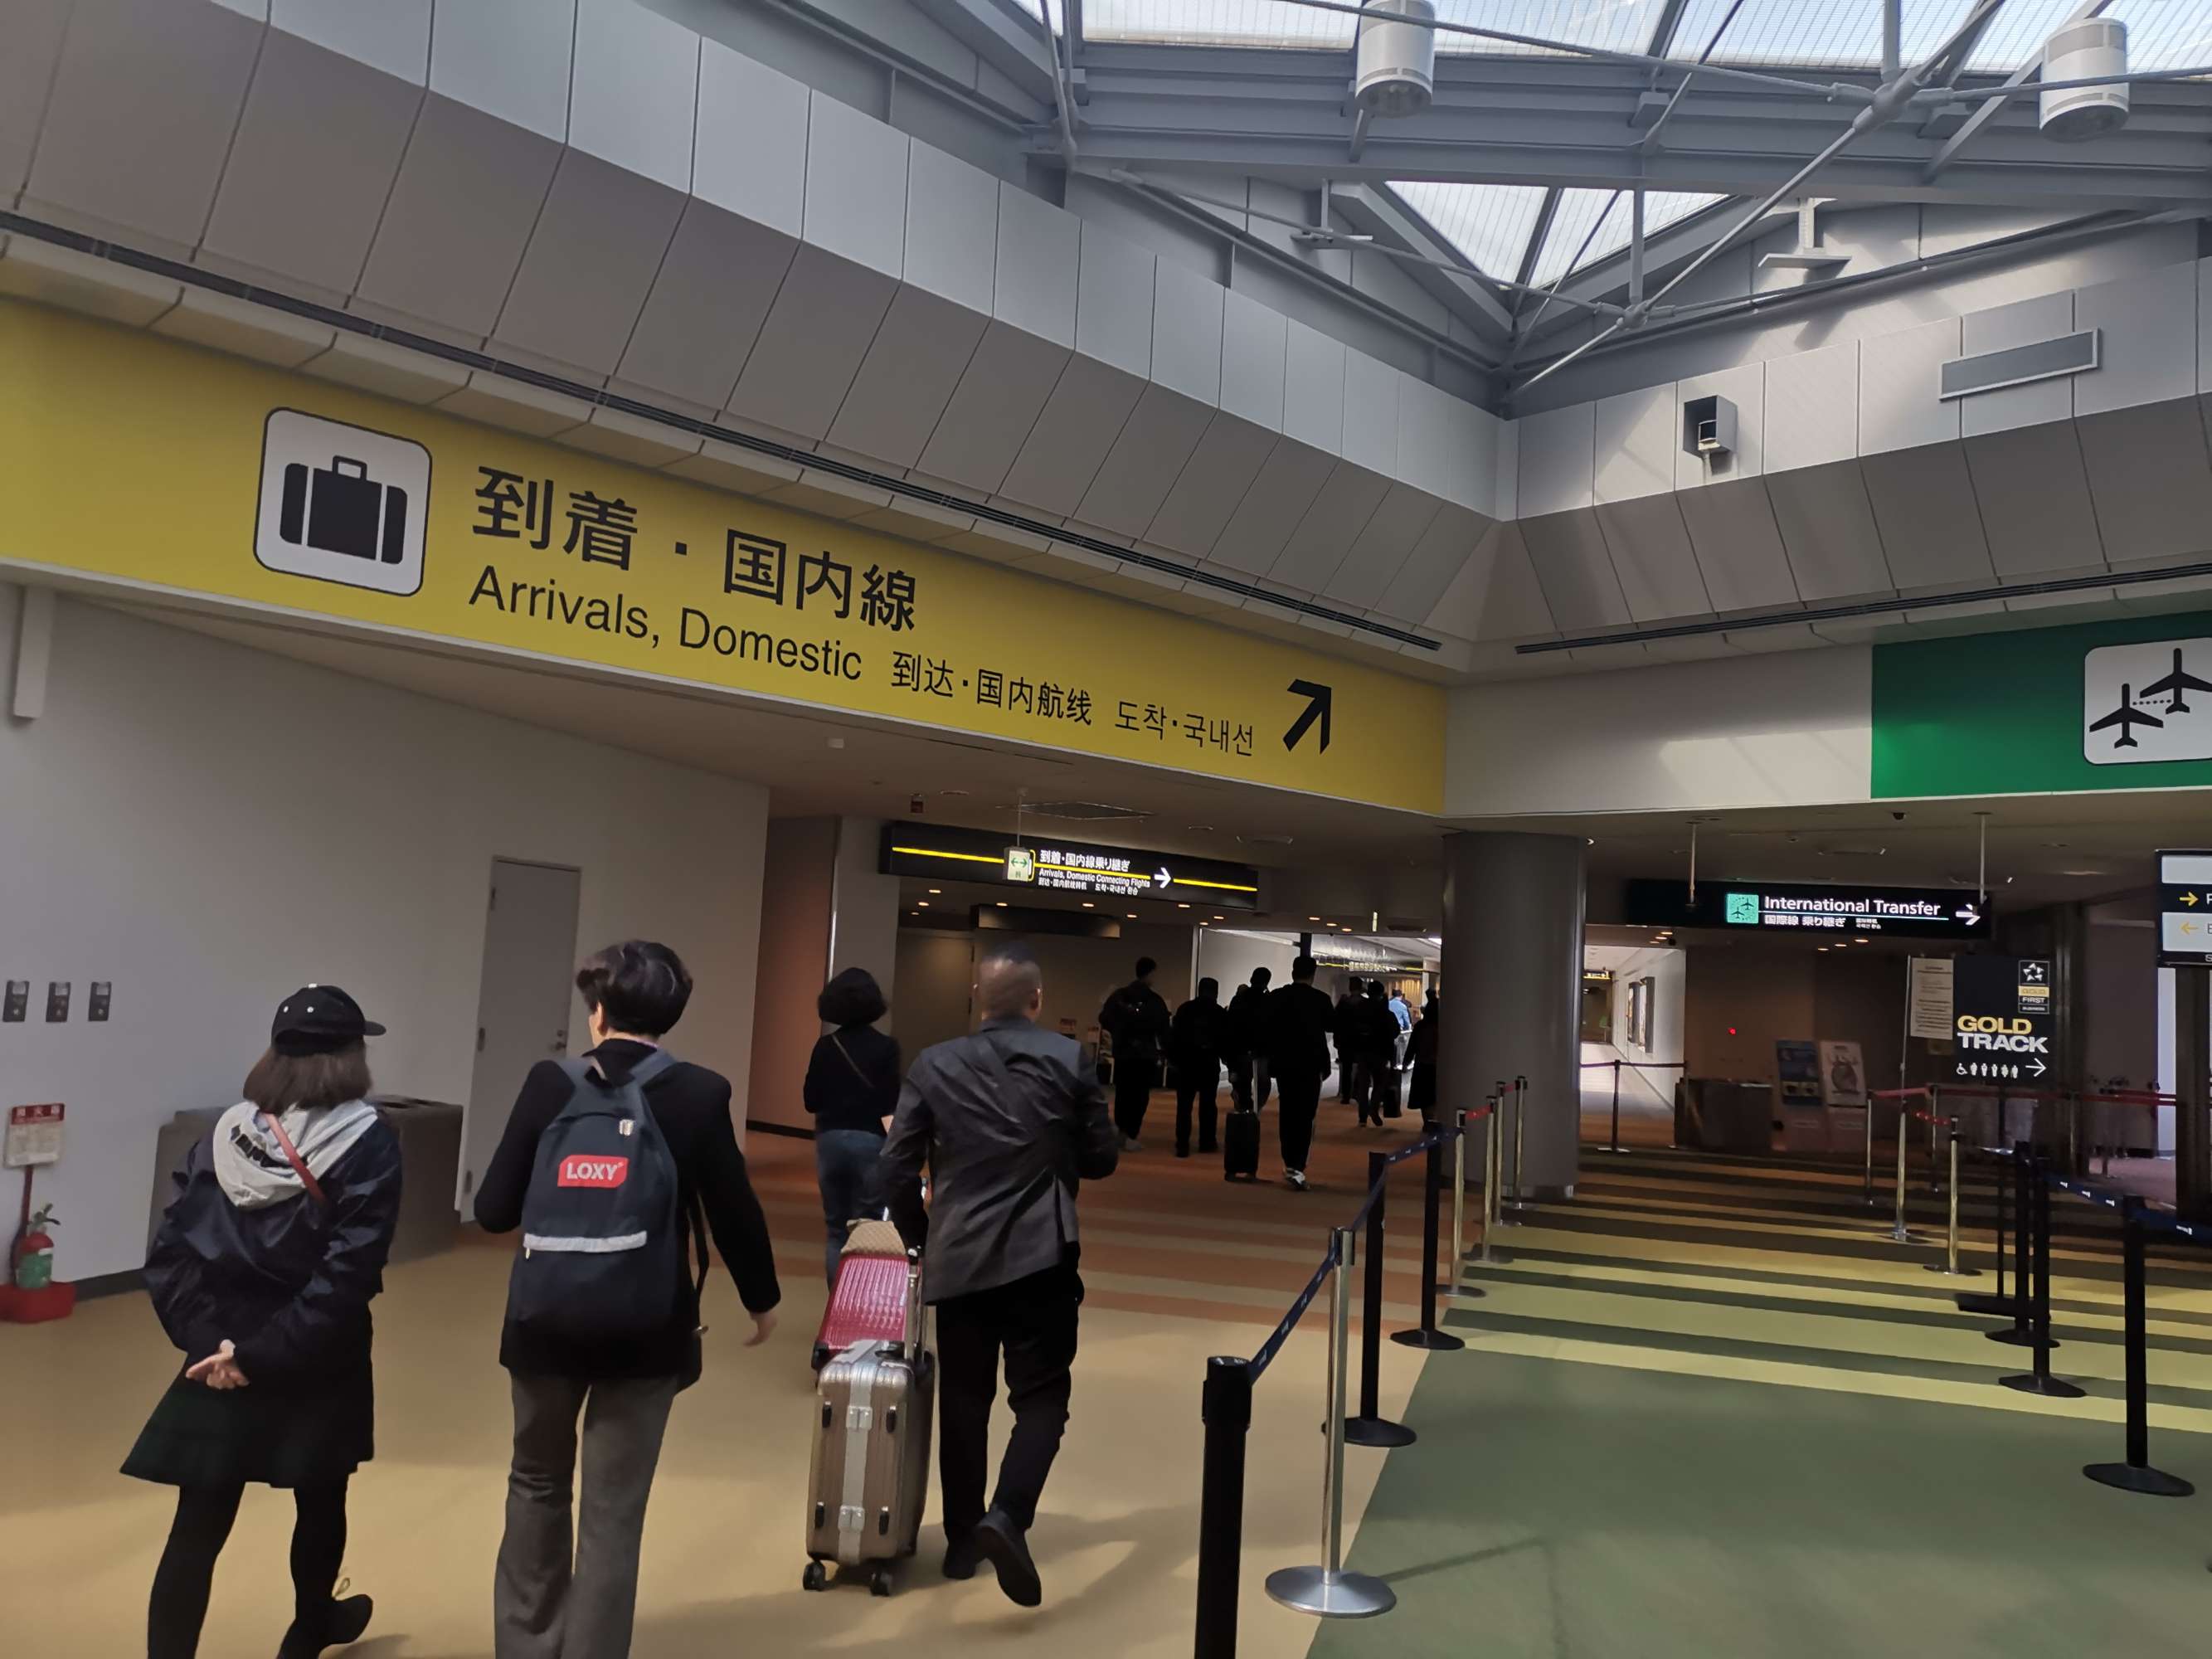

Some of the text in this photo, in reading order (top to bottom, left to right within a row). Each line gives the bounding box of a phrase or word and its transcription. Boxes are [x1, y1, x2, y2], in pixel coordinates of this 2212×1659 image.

[469, 564, 862, 680] Arrivals, Domestic
[1038, 868, 1150, 888] Arrivals, Domestic Connecting Flights
[1764, 895, 1942, 916] International Transfer
[1957, 1014, 2032, 1034] GOLD
[1957, 1032, 2049, 1053] TRACK
[566, 1162, 618, 1180] LOXY
